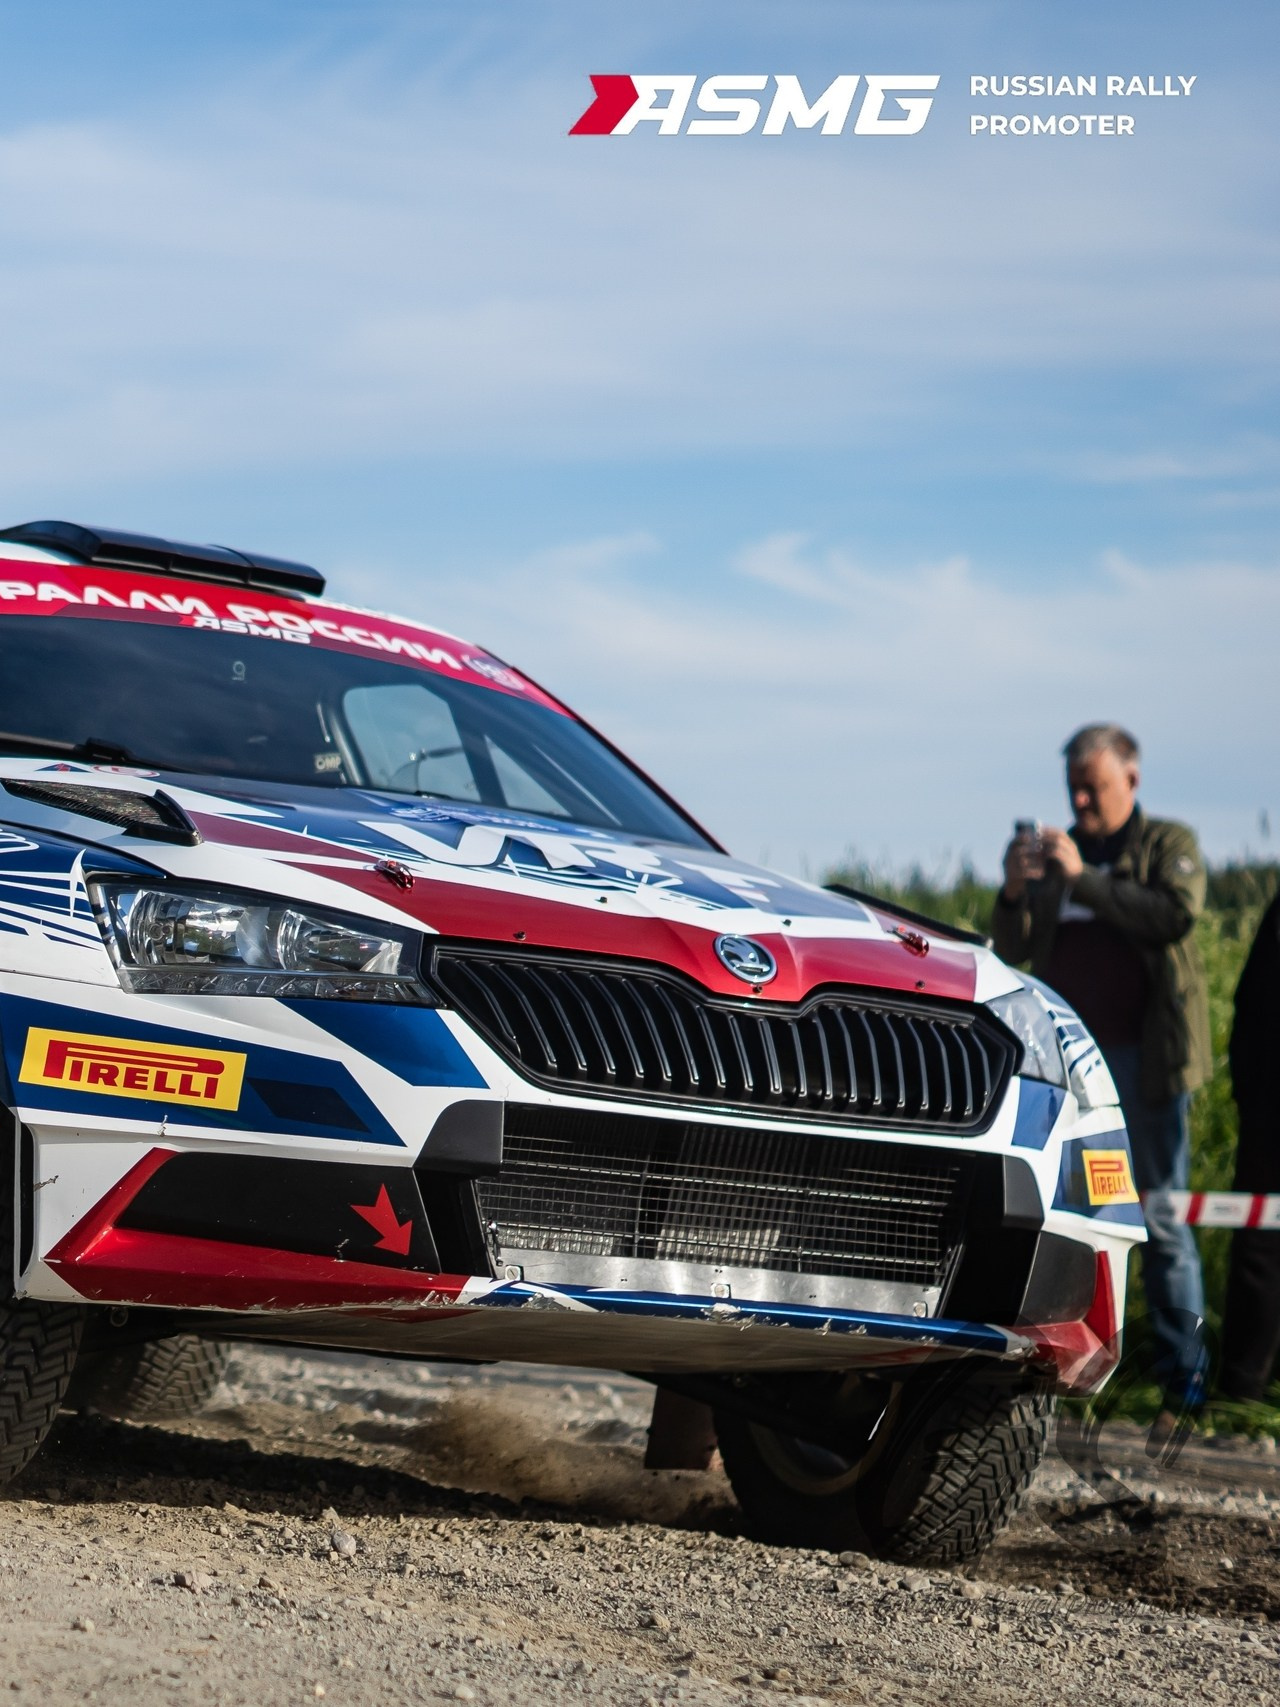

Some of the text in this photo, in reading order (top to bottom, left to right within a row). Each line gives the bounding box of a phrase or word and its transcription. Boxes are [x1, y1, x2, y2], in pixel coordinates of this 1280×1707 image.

[192, 615, 313, 644] ASMG
[227, 602, 463, 671] РОССИИ
[42, 1039, 226, 1100] PIRELLI
[1089, 1160, 1130, 1196] PIRELLI
